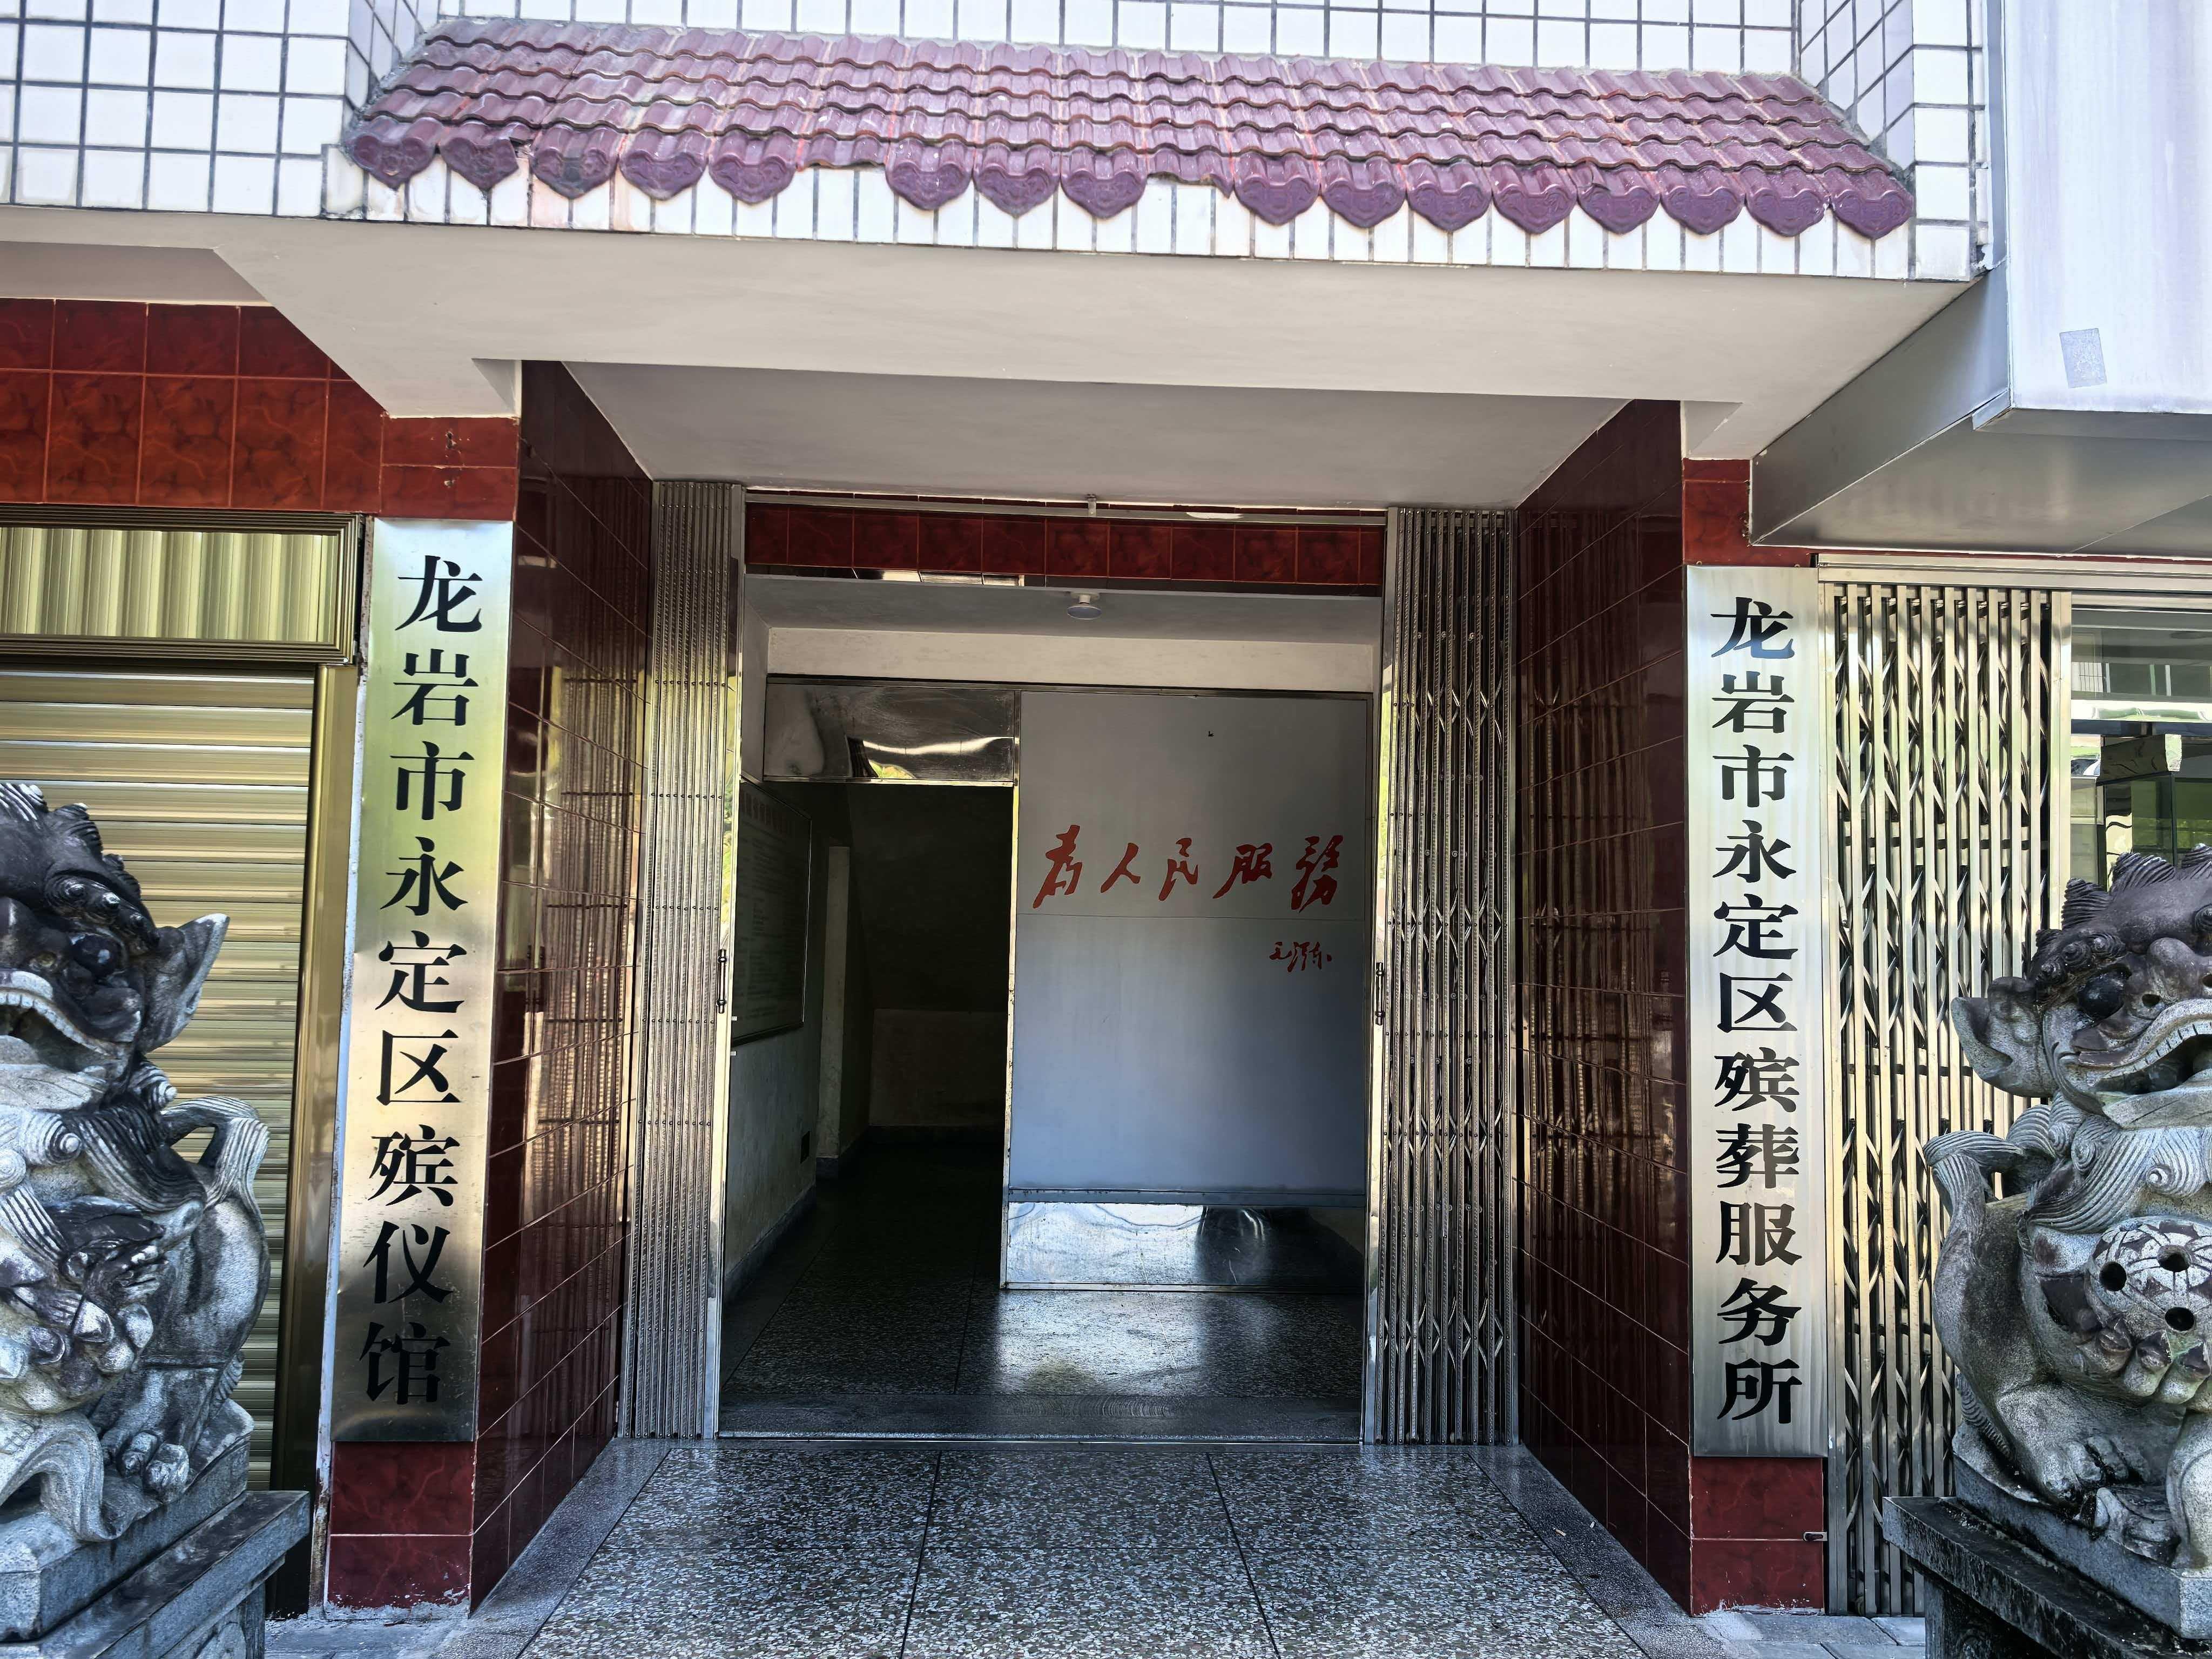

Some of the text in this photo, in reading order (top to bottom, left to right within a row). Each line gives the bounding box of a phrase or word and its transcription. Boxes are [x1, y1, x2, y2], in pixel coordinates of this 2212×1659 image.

[359, 555, 483, 1405] 龙岩市永定区殡仪馆
[1711, 597, 1803, 1424] 龙岩市永定区殡葬服务所
